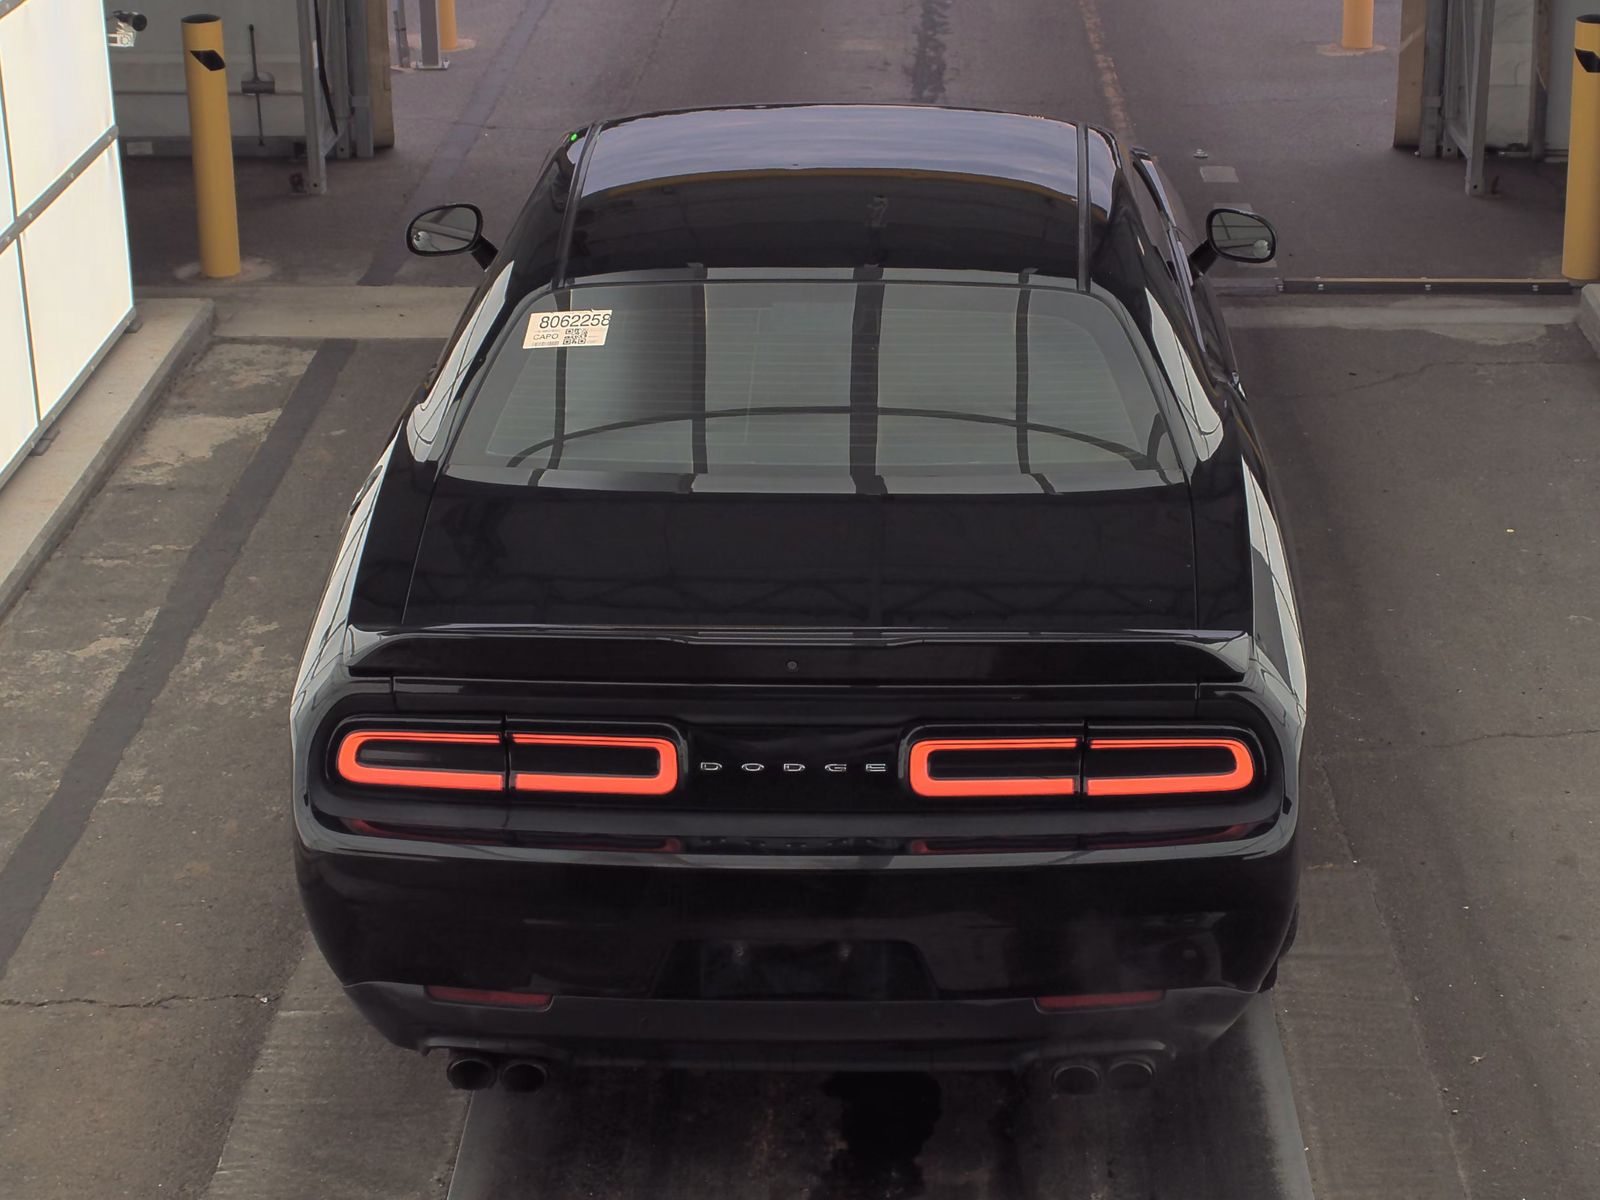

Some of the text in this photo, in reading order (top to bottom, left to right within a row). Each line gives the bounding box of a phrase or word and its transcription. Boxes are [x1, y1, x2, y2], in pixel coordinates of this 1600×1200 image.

[540, 313, 611, 329] 8062258
[533, 333, 559, 341] CAPO
[700, 761, 886, 772] DODGE
